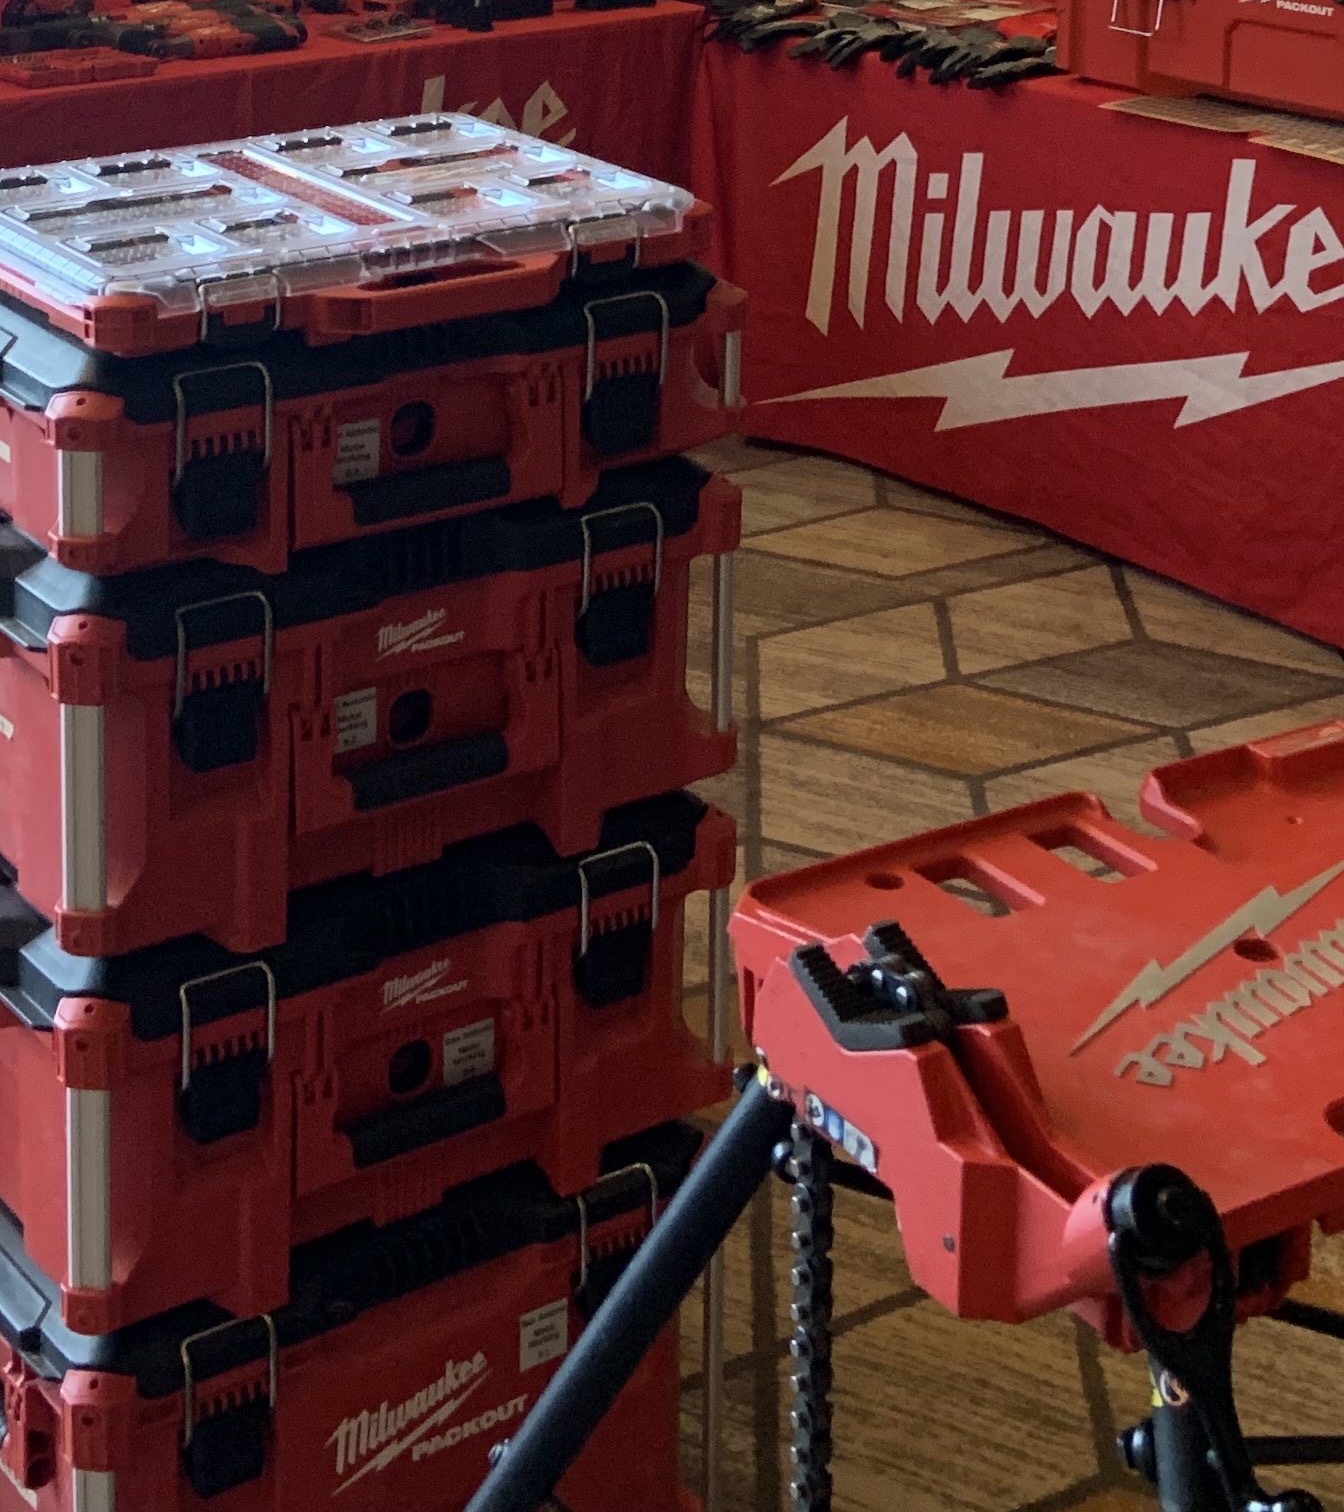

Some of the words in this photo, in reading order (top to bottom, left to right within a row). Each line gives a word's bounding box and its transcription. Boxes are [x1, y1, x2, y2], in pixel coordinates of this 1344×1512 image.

[1276, 0, 1334, 17] PACKOUT
[323, 1351, 488, 1475] Milwaukee
[411, 1394, 529, 1462] PACKOUT
